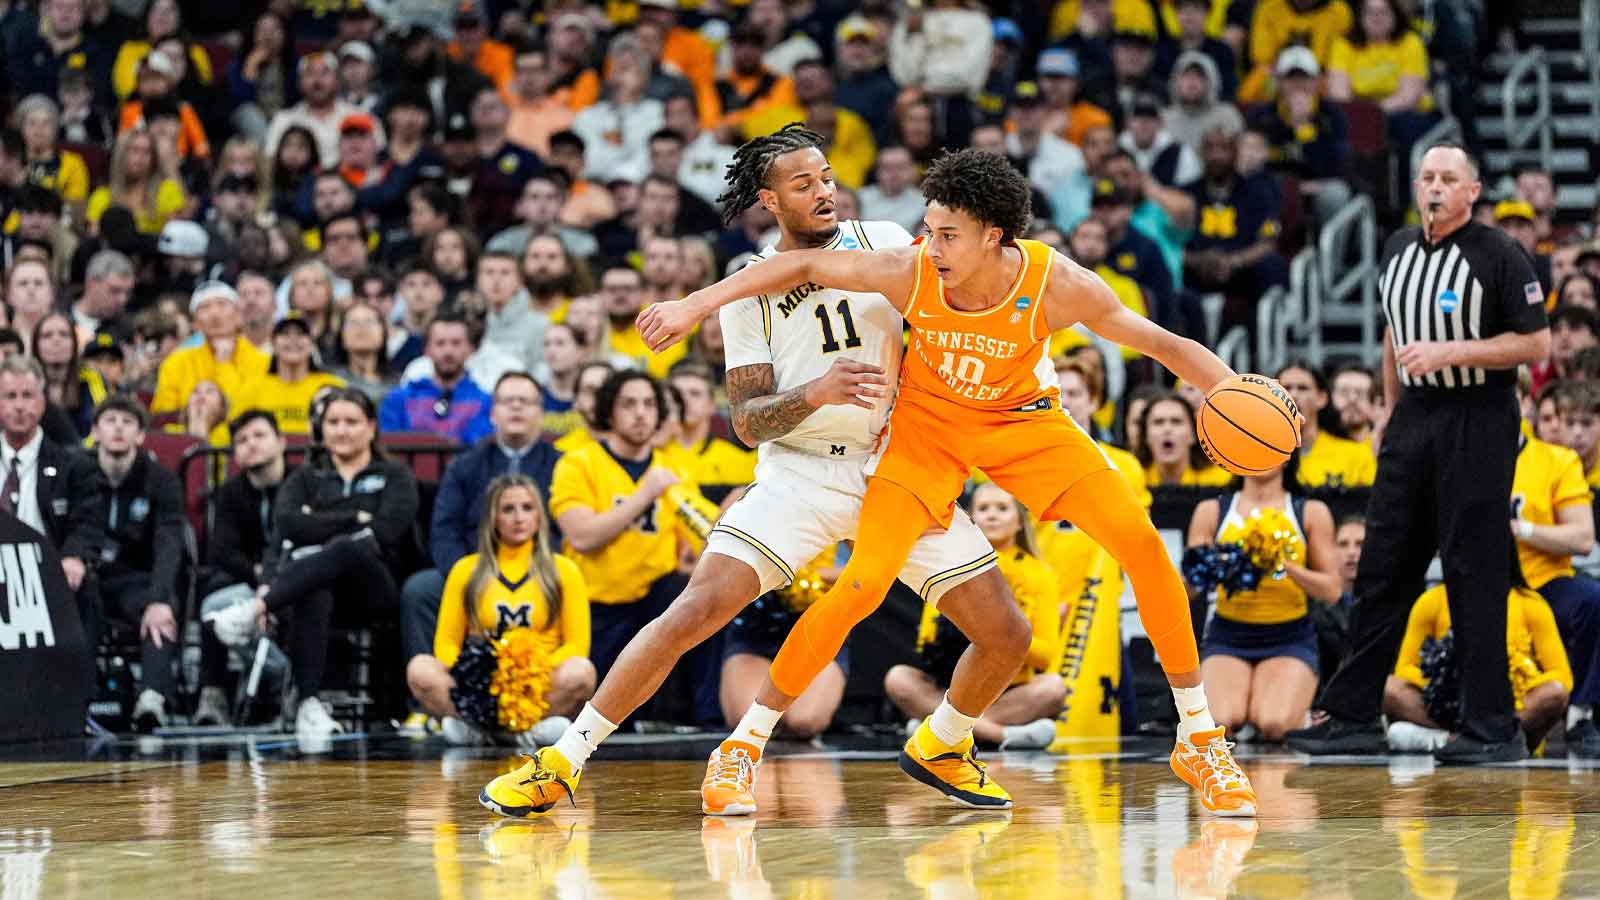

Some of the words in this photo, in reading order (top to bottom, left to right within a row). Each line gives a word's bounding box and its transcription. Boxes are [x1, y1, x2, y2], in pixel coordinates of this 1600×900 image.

[815, 299, 862, 353] 11
[915, 327, 1018, 359] TENNESSEE
[830, 444, 847, 456] M
[496, 603, 531, 628] M
